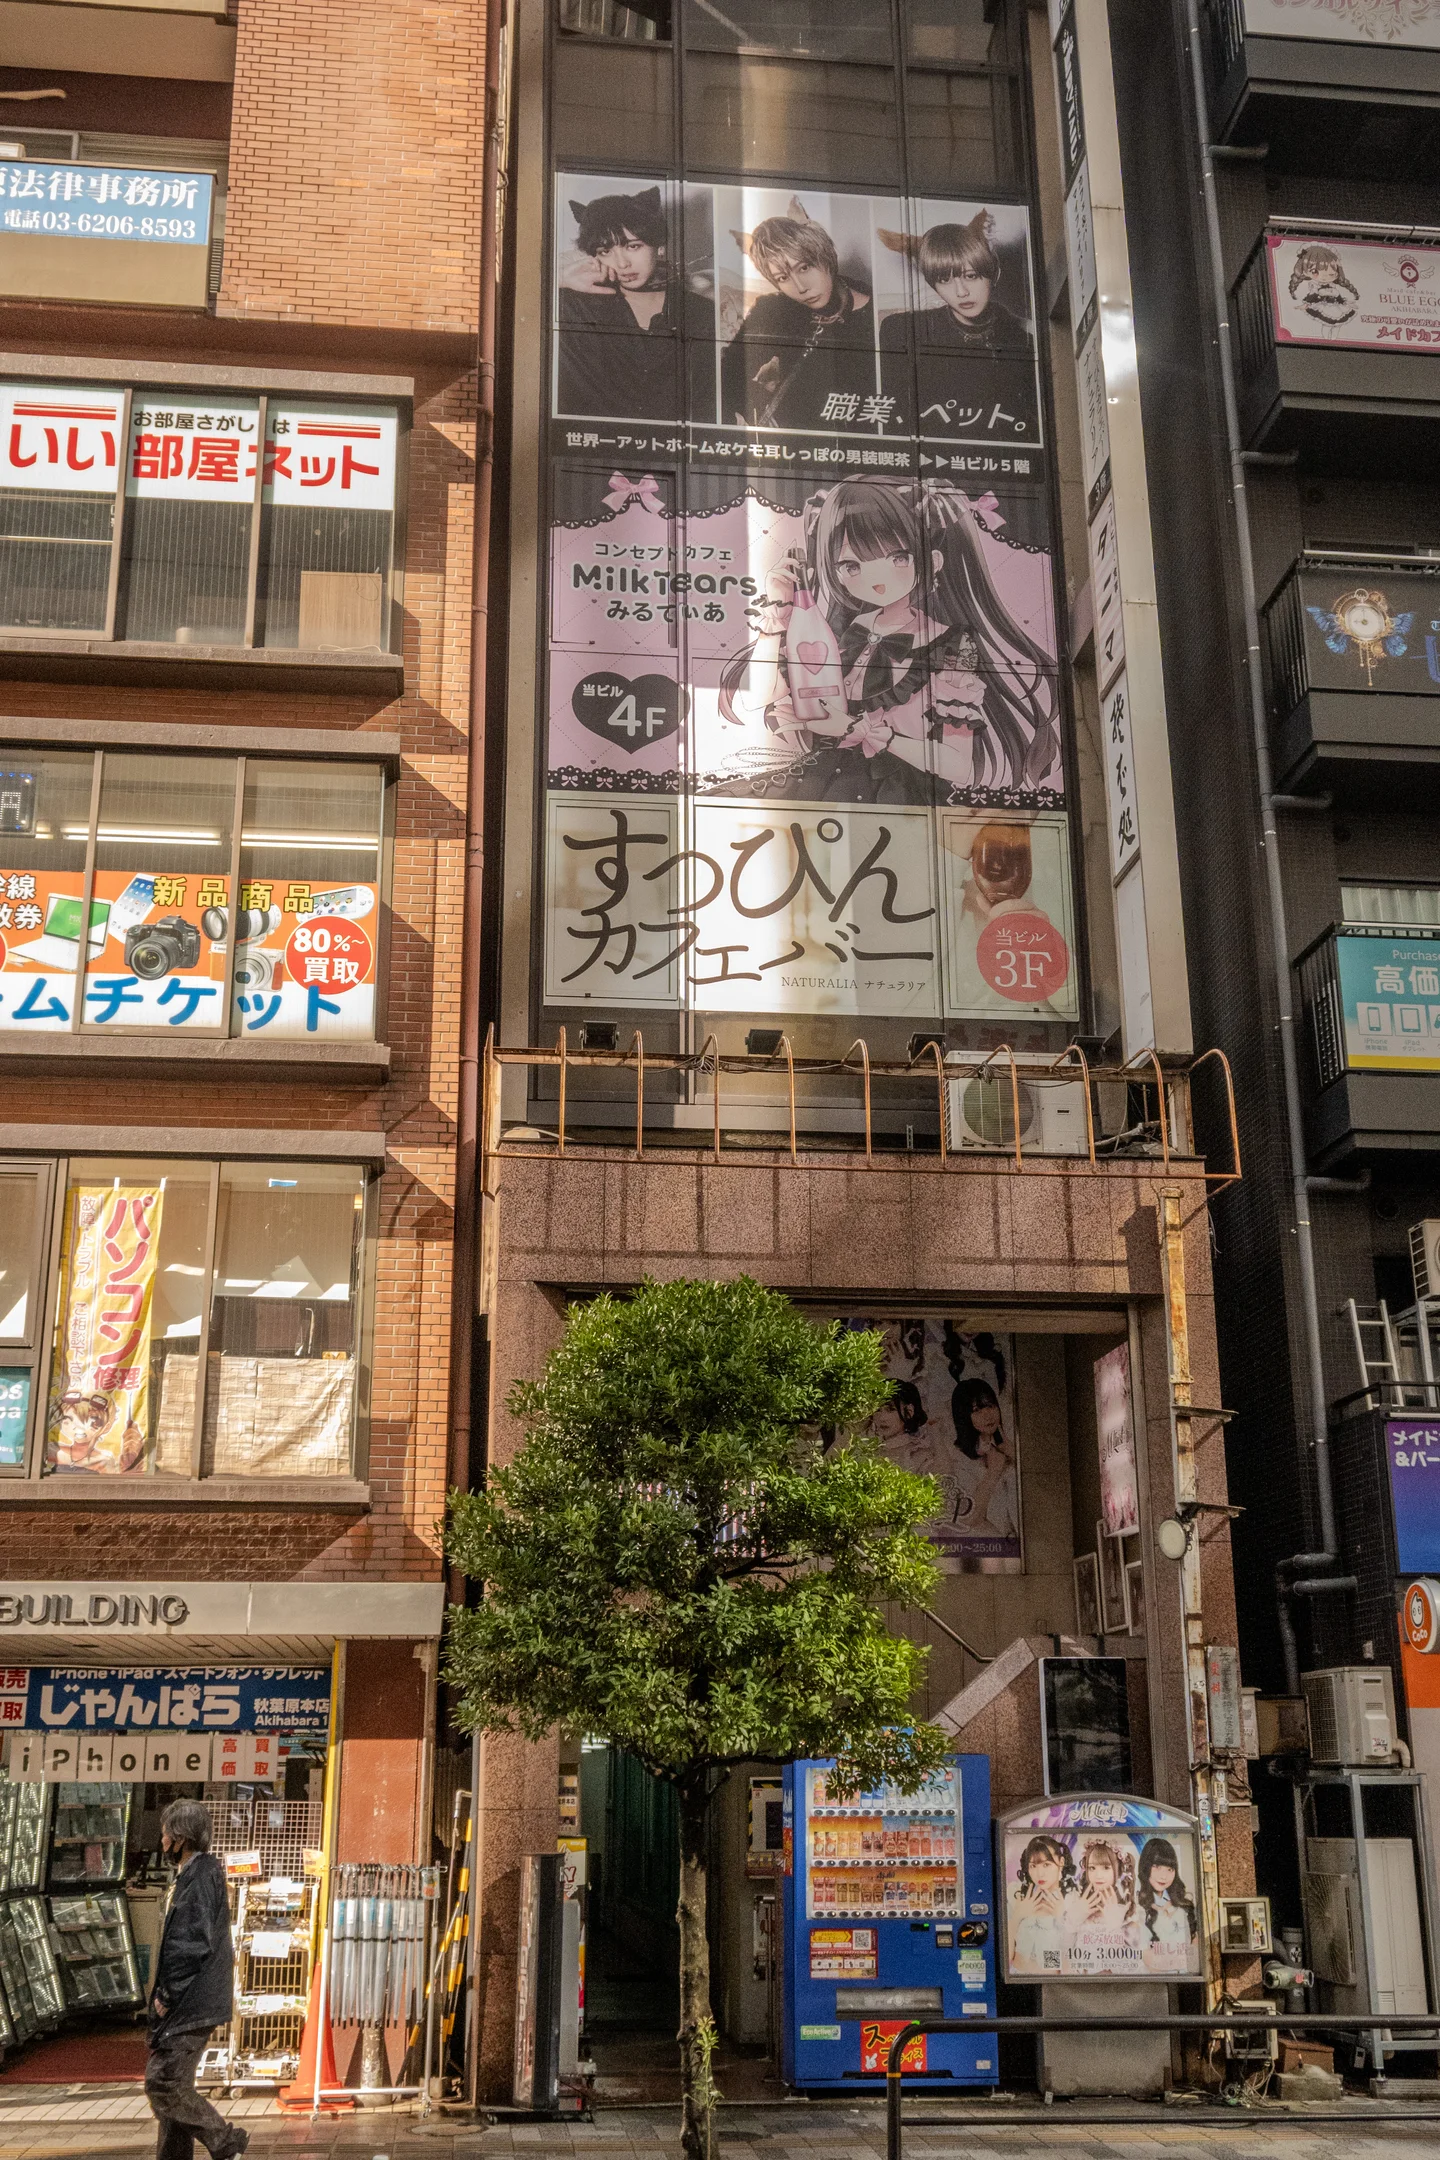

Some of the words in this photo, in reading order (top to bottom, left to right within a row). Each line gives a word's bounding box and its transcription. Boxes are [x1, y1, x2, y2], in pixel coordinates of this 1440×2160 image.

[0, 167, 199, 209] 法律事務所
[4, 208, 196, 239] 電話03-6206-8593
[1379, 294, 1415, 305] BLUE
[1391, 306, 1438, 315] AKIHABARA
[819, 391, 1027, 433] 職業、ペット。
[8, 422, 380, 490] いい部屋ネット
[566, 430, 911, 468] 世界一アットホームなケモ耳しっぽの男装喫茶
[582, 683, 624, 698] 当ビル
[607, 694, 667, 738] 4F
[0, 872, 37, 901] 線
[561, 907, 934, 984] カフェバー
[997, 928, 1047, 947] 当ビル
[303, 957, 360, 985] 買取
[781, 976, 859, 990] NATURALIA
[864, 980, 927, 993] ナチュラリア
[994, 950, 1052, 990] 3F
[1373, 964, 1439, 996] 高価
[0, 976, 342, 1032] ムチケット
[0, 1594, 190, 1626] BUILDING
[0, 1700, 23, 1721] 取
[253, 1697, 329, 1715] 秋葉原本店
[40, 1683, 241, 1726] じゃんぱら
[254, 1714, 320, 1726] Akihabara
